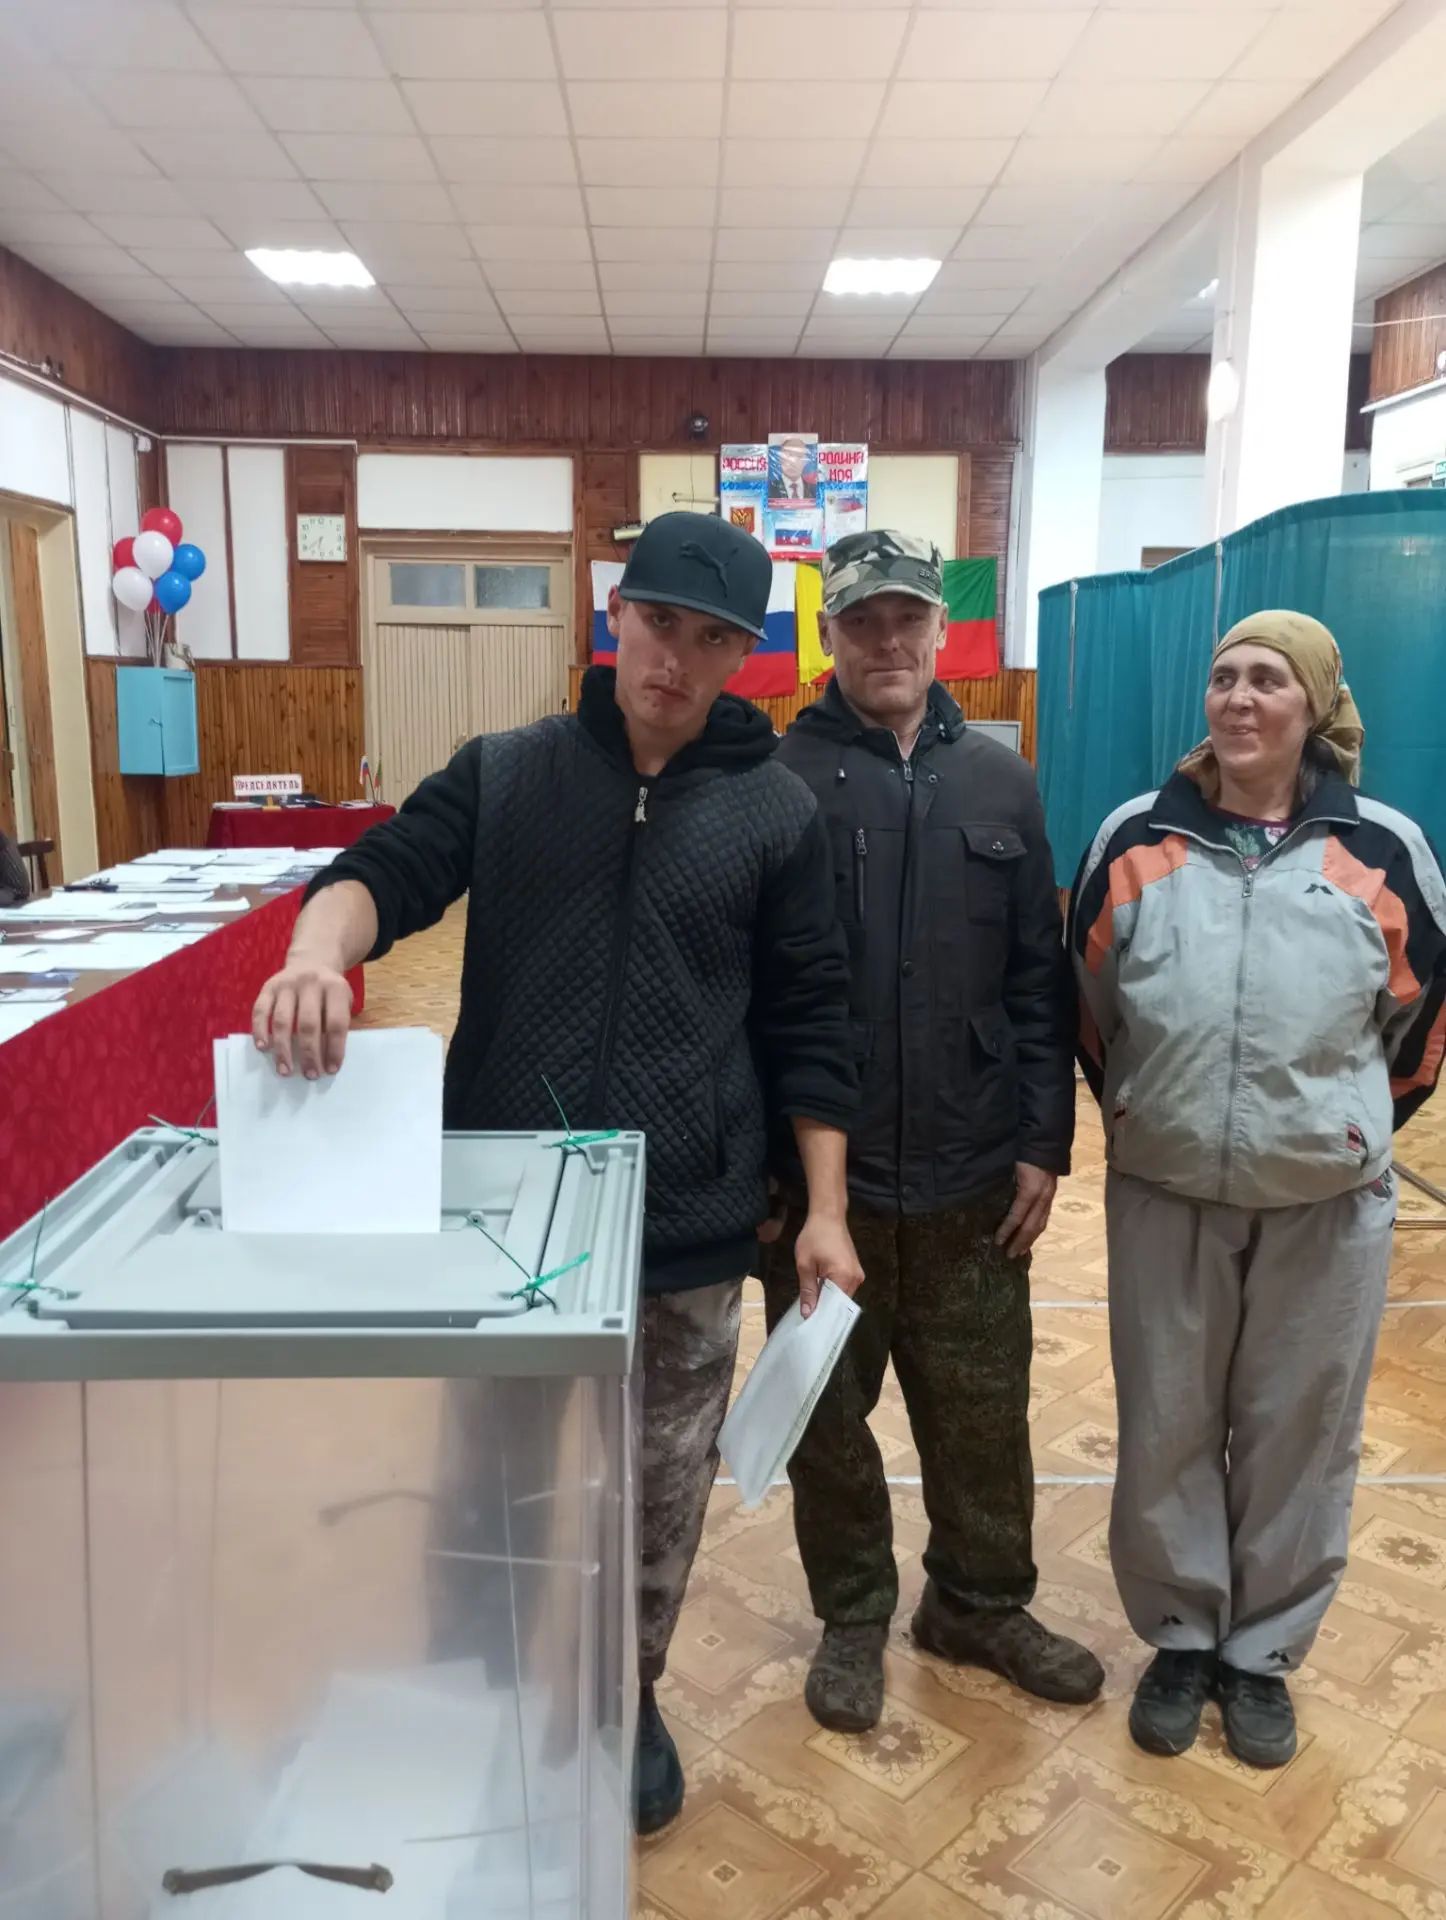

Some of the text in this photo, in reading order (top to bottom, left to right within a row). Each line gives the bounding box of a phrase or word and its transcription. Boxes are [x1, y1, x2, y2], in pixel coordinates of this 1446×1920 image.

[722, 457, 768, 471] РОССИЯ
[818, 451, 865, 464] РОДИНА
[829, 469, 853, 482] МОЯ
[235, 780, 299, 791] ПРЕДСЕДАТЕЛЬ
